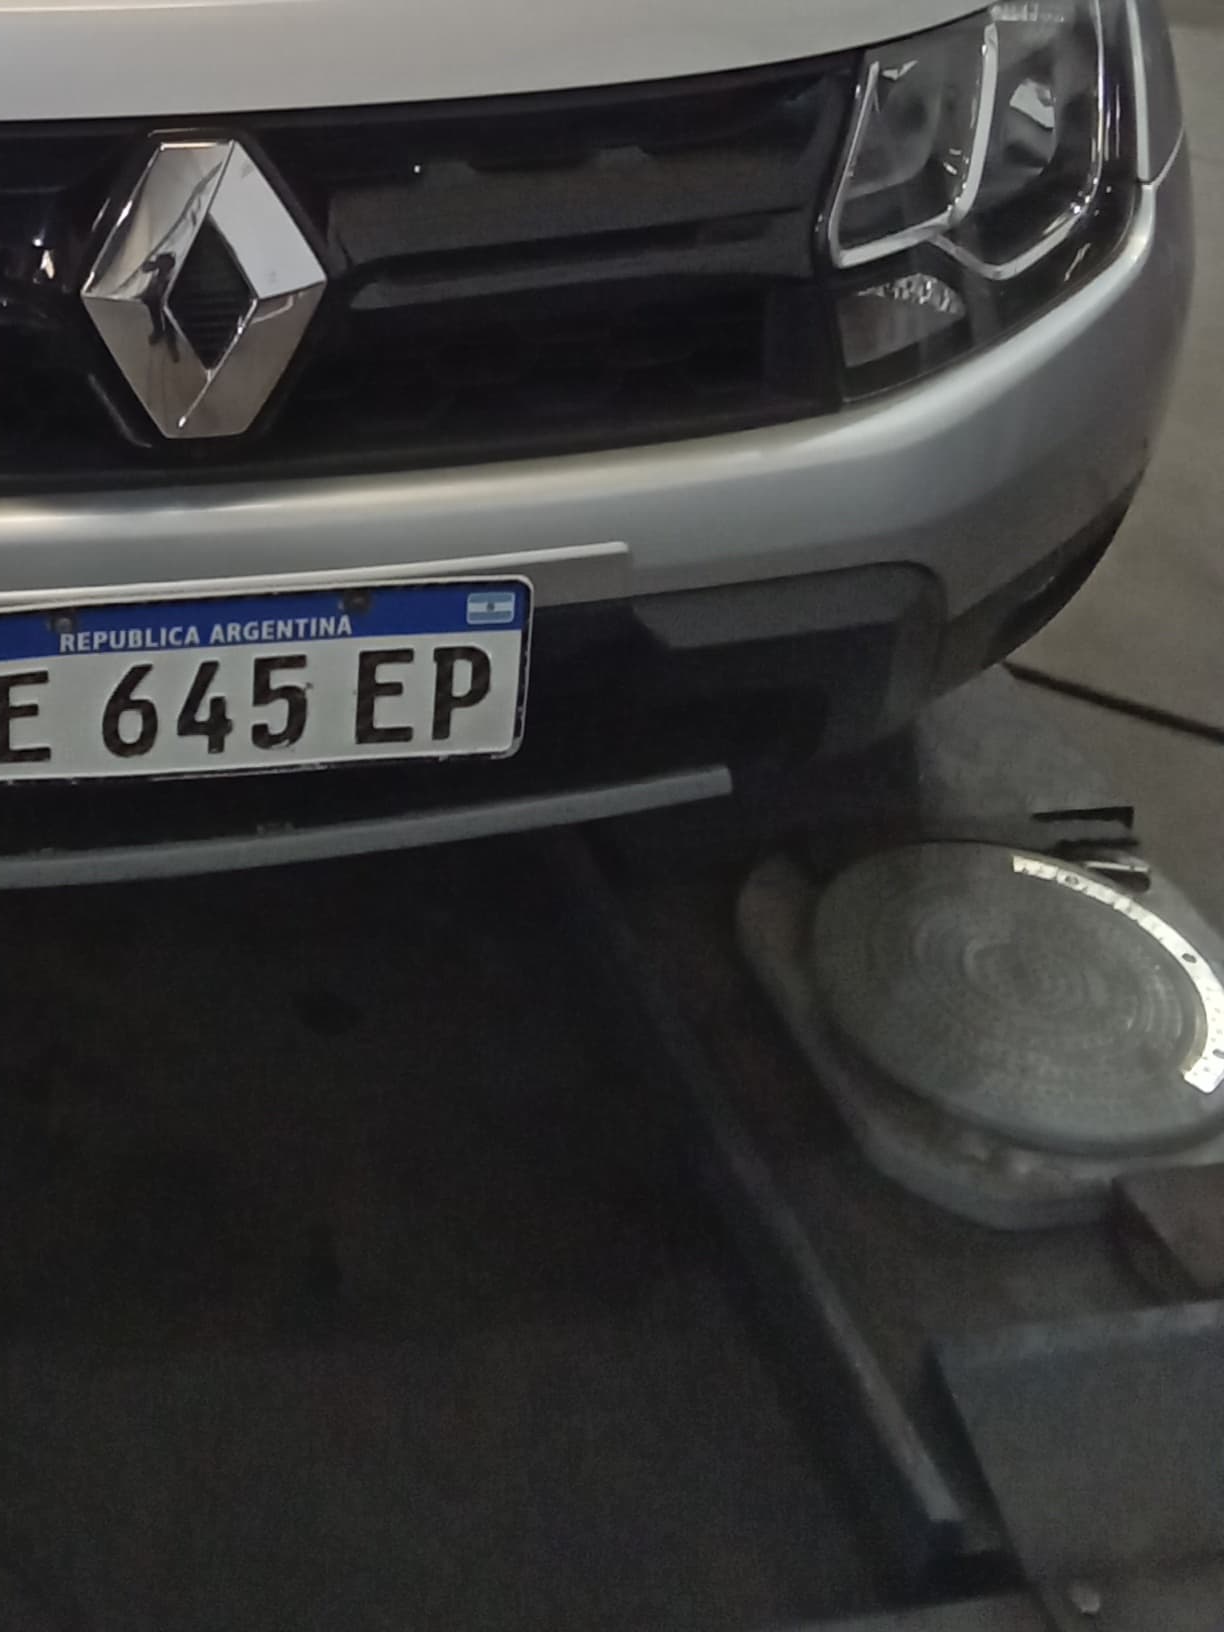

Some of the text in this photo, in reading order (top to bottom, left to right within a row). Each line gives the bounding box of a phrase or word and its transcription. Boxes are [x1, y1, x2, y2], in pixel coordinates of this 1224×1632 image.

[60, 614, 353, 653] REPUBLICA ARGENTINA
[102, 654, 309, 758] 645
[355, 645, 492, 745] EP
